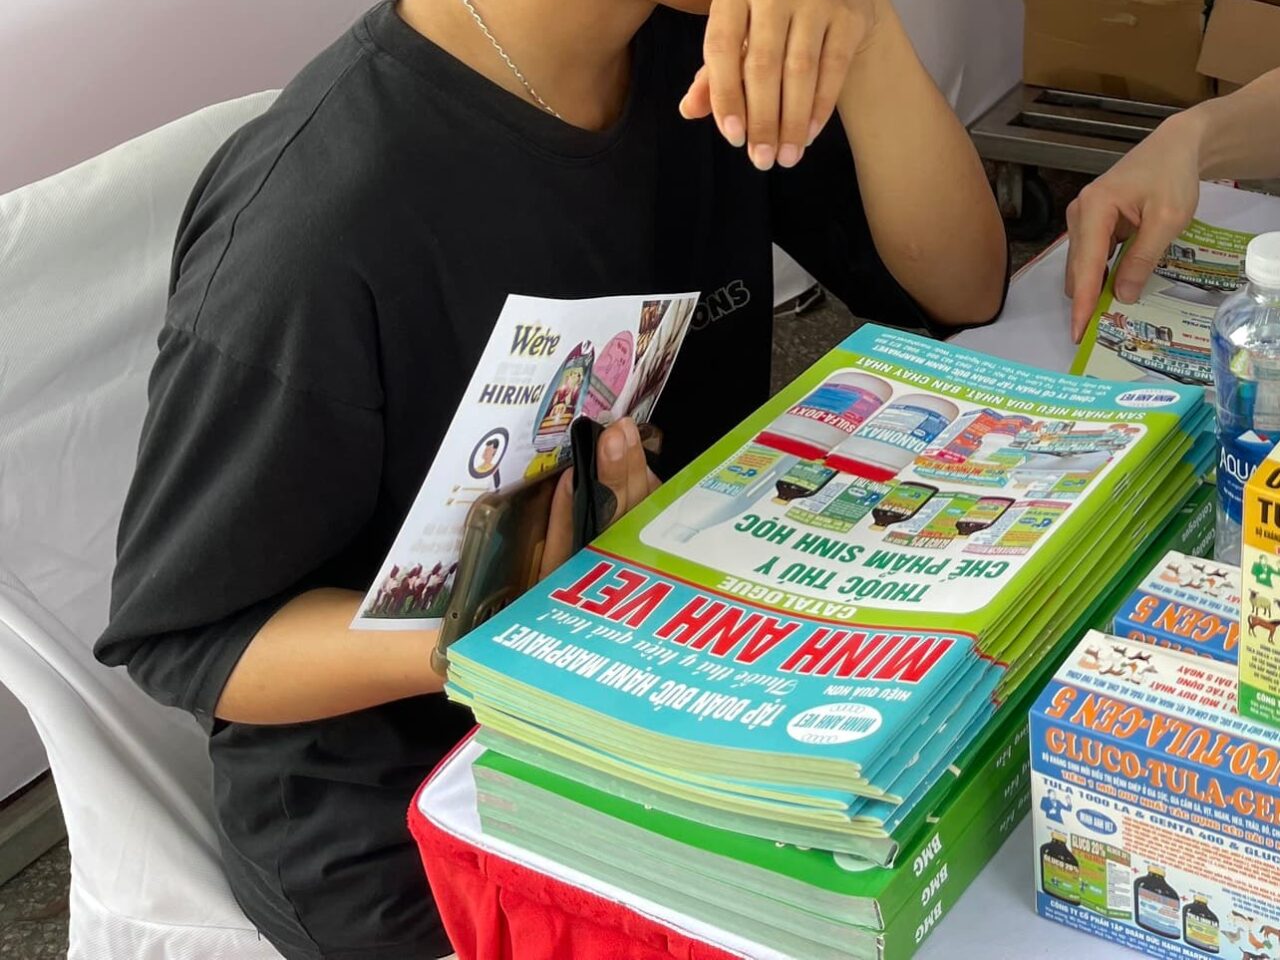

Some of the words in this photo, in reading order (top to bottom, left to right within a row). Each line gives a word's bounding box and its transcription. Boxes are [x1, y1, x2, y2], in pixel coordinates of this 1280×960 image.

[691, 280, 750, 330] ONS
[478, 383, 545, 405] HIRING!
[733, 512, 797, 544] HỌC
[753, 555, 780, 573] Y
[791, 534, 866, 563] SINH
[863, 549, 952, 578] PHẨM
[778, 561, 839, 590] THÚ
[940, 559, 1011, 583] CHẾ
[548, 560, 675, 631] VET
[717, 576, 858, 619] CATALOGUE
[837, 575, 931, 603] THUỐC
[653, 596, 802, 665] ANH
[778, 627, 956, 684] MINH
[1045, 686, 1077, 718] 5
[913, 832, 942, 877] BMG
[922, 863, 948, 906] BMG
[915, 900, 942, 944] BMG
